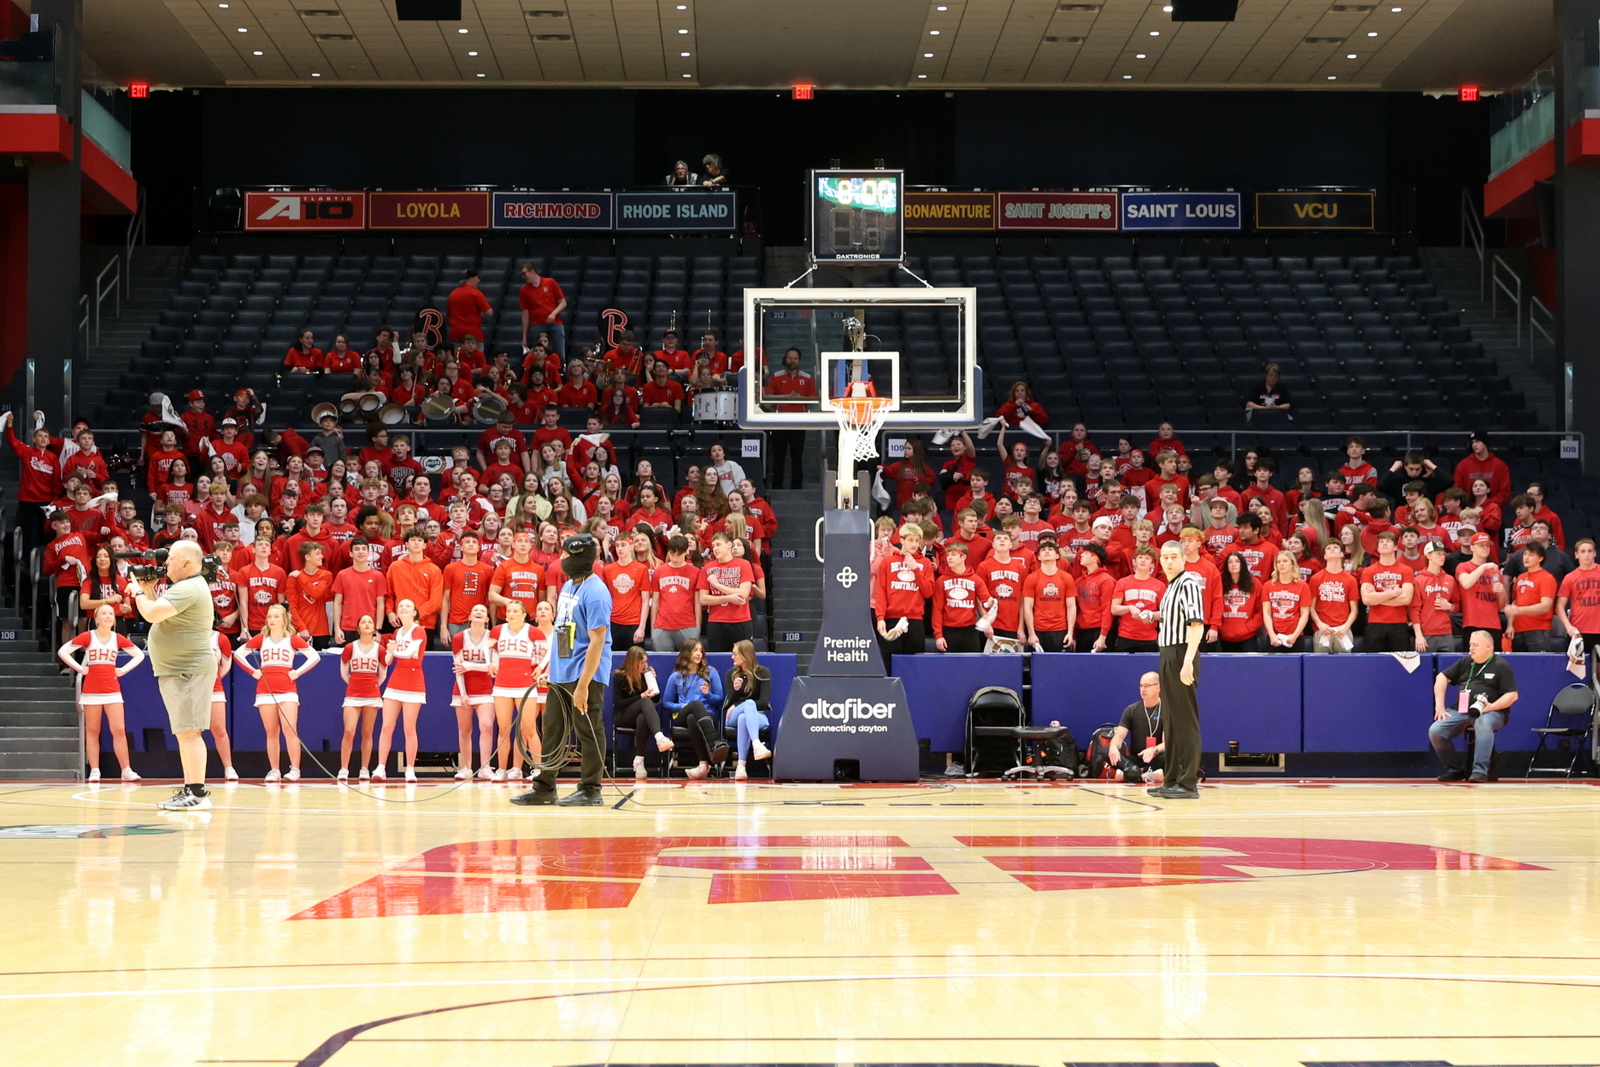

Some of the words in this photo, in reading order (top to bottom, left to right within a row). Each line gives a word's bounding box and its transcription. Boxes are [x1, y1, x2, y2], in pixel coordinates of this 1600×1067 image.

[131, 85, 147, 98] EXIT
[795, 86, 811, 100] EXIT
[1461, 88, 1478, 101] EXIT
[396, 203, 461, 218] LOYOLA
[504, 203, 601, 218] RICHMOND
[623, 204, 671, 219] RHODE
[676, 204, 728, 218] ISLAND
[904, 204, 992, 219] BONAVENTURE
[1005, 203, 1045, 218] SAINT
[1048, 203, 1111, 220] JOSEPH'S
[1127, 204, 1179, 218] SAINT
[1185, 204, 1237, 218] LOUIS
[1293, 203, 1338, 219] VCU
[1207, 535, 1234, 544] JESUS
[782, 550, 796, 558] 108
[249, 577, 278, 588] BELLEVUE
[989, 570, 1020, 583] BELLEVUE
[0, 631, 15, 640] 108
[785, 633, 800, 641] 108
[823, 636, 871, 648] Premier
[499, 640, 528, 653] BHS
[89, 649, 116, 662] BHS
[262, 649, 290, 662] BHS
[826, 650, 869, 662] Health
[351, 658, 377, 671] BHS
[801, 698, 896, 724] altafiber
[810, 724, 857, 734] connecting
[857, 725, 888, 734] dayton
